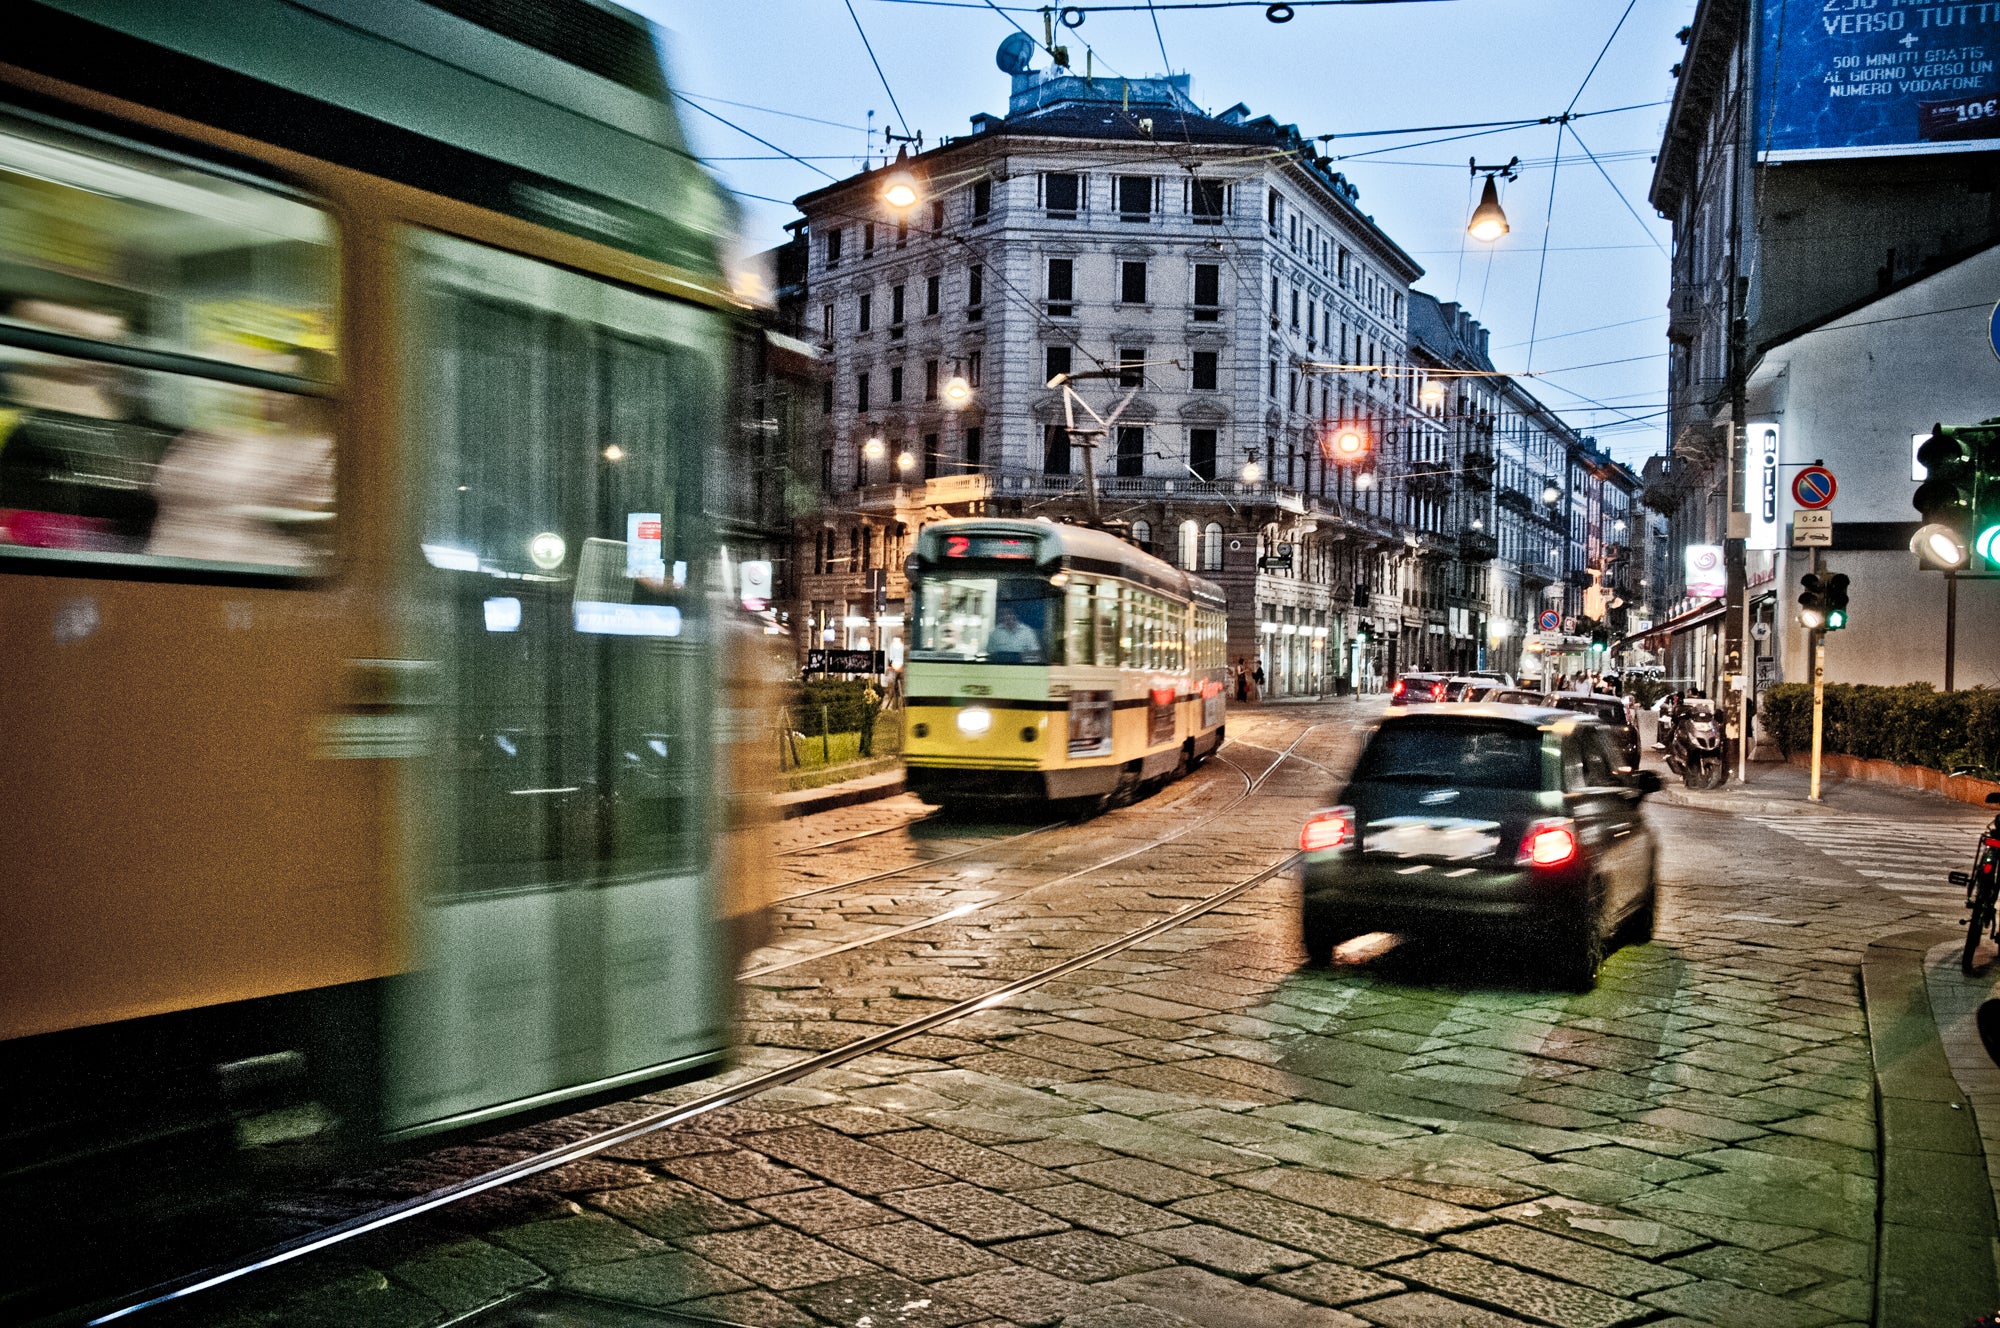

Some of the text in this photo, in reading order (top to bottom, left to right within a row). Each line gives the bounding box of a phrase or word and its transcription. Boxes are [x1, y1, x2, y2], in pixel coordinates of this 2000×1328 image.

[1822, 2, 2000, 35] VERSO TUTTI
[1833, 46, 1984, 68] 500 MINUTI GRATIS
[1823, 60, 1993, 83] AL GIORNO VERSO UN
[1830, 76, 1984, 97] NUMERO VODAFONE
[1956, 99, 1997, 122] 10€
[1763, 435, 1776, 518] HOTEL
[1802, 515, 1823, 523] 0-24
[947, 536, 970, 558] 2
